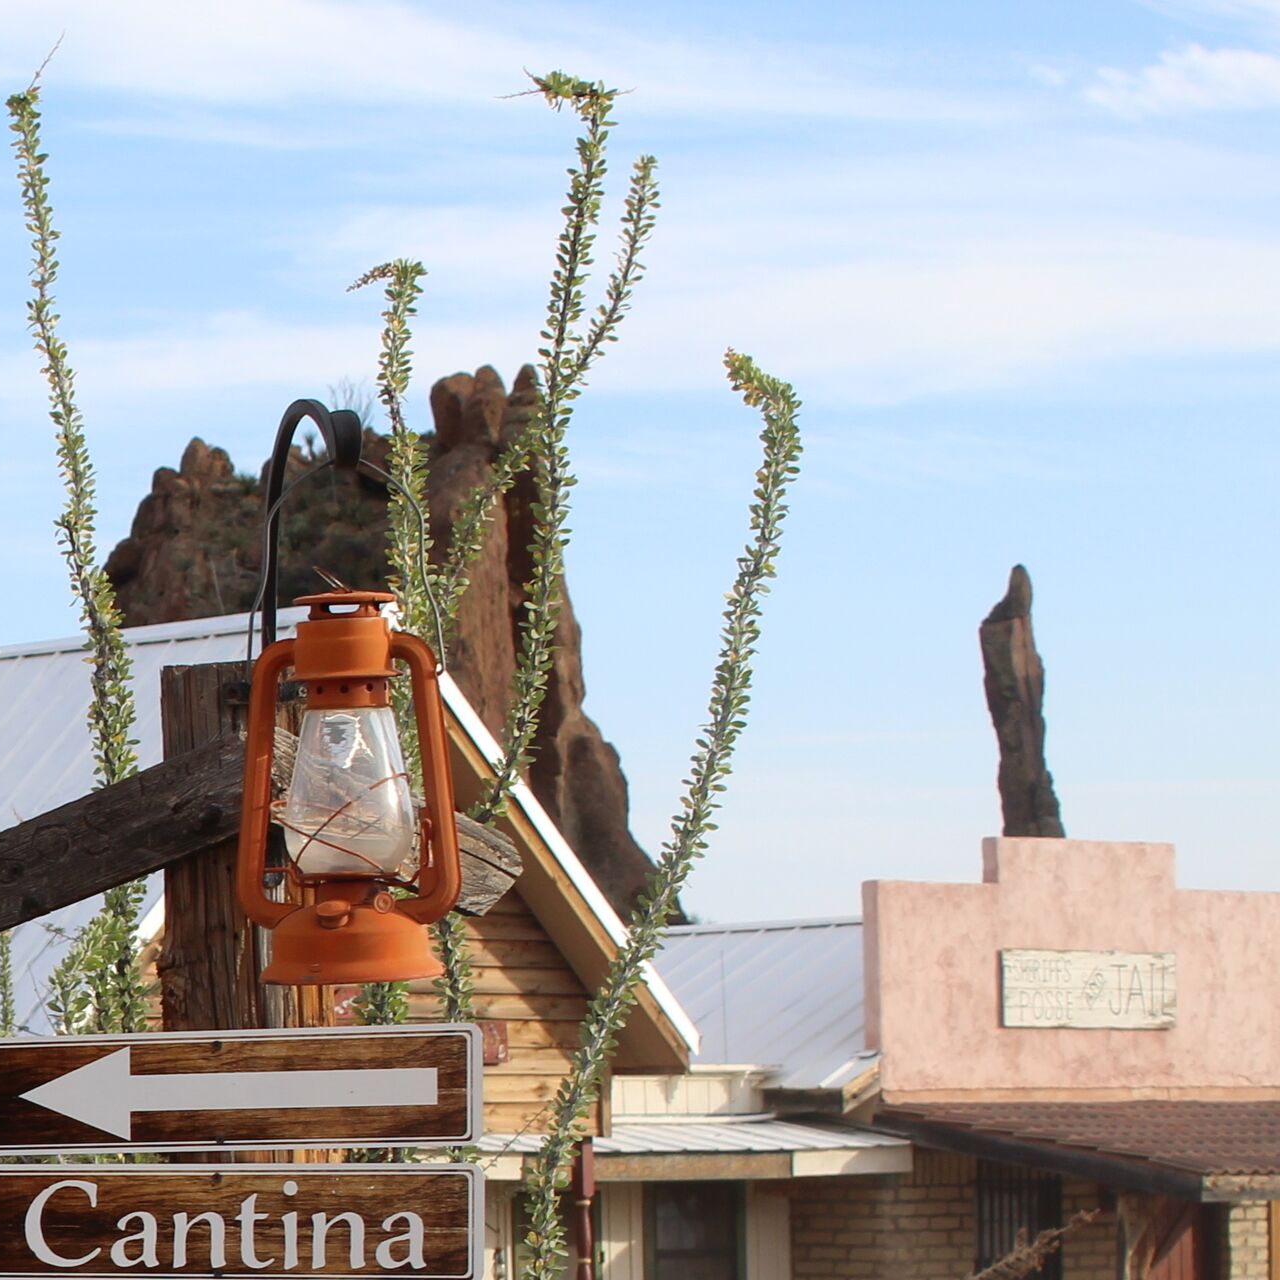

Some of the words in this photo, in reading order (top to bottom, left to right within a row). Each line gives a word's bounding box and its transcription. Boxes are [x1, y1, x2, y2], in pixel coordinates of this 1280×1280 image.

[1019, 990, 1073, 1022] POSSE
[1108, 962, 1176, 1018] JAIL
[24, 1179, 427, 1271] Cantina
